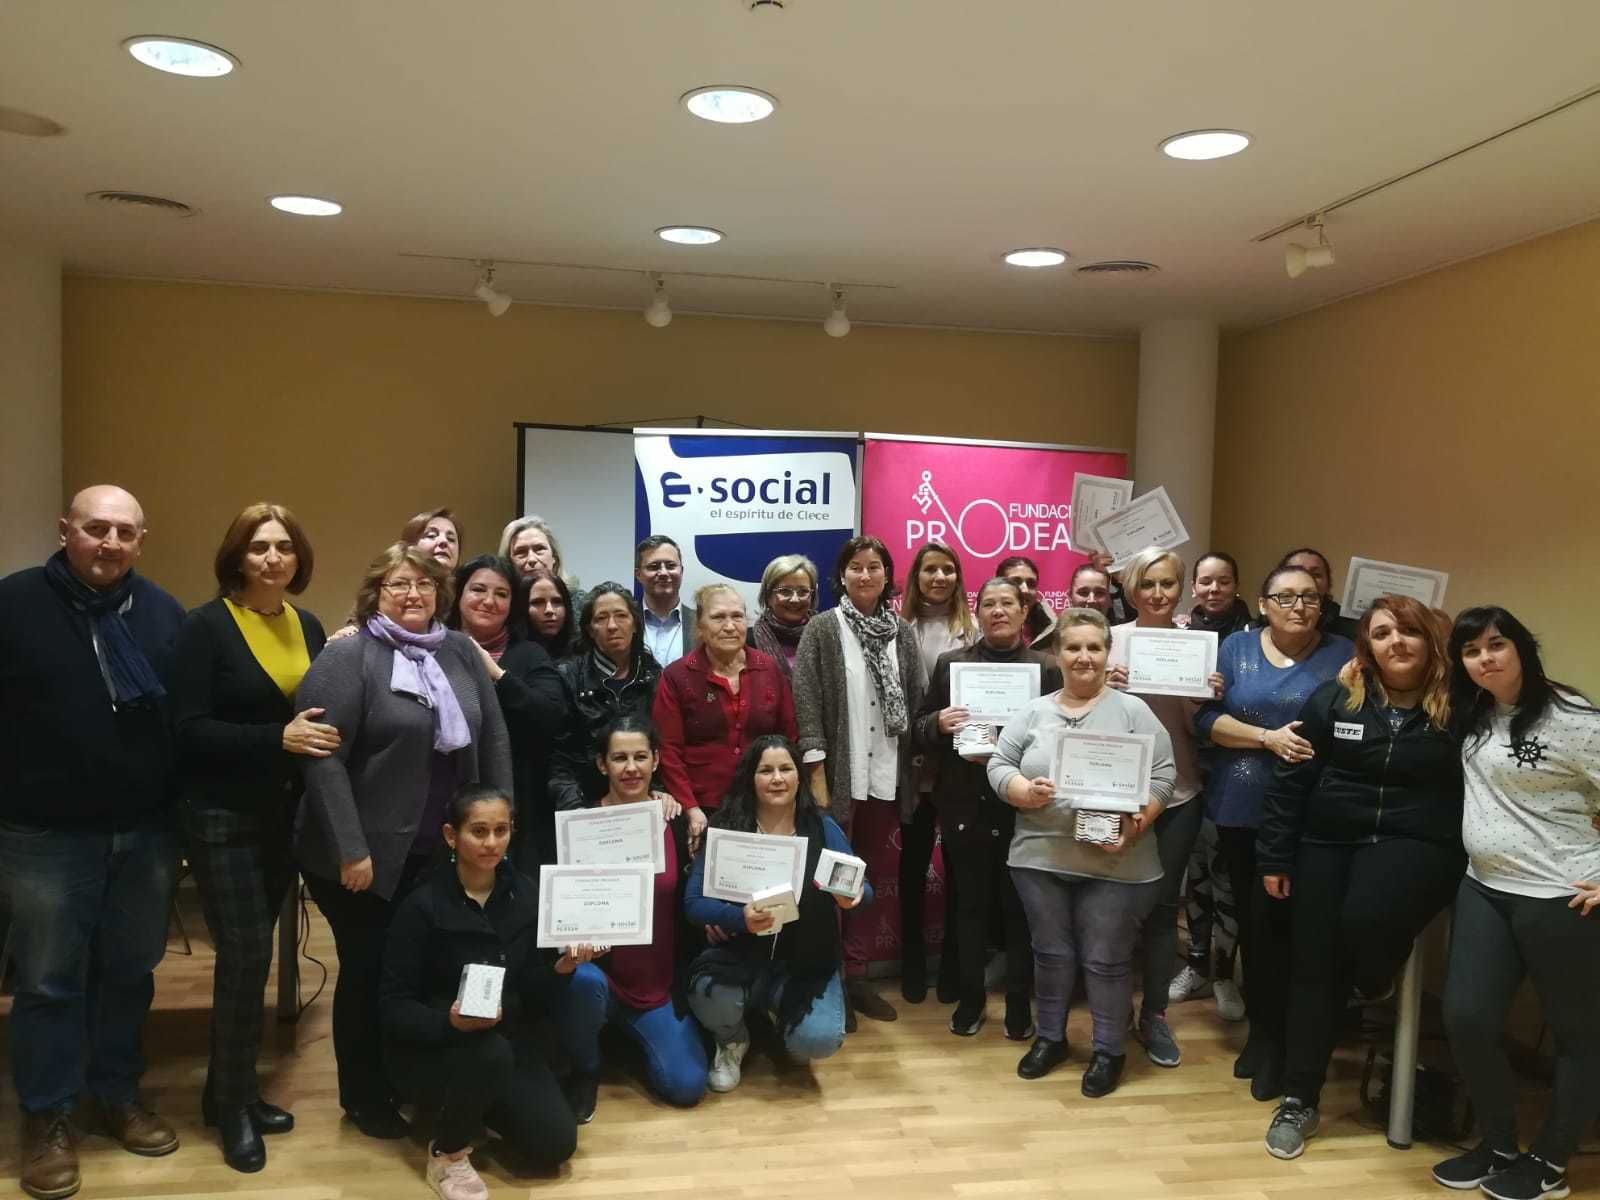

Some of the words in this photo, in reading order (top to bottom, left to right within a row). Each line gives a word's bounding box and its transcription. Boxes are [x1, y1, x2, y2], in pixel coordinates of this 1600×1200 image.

[710, 509, 722, 518] el
[777, 510, 794, 520] de
[797, 510, 830, 521] Clece
[1009, 503, 1072, 519] FUNDACI
